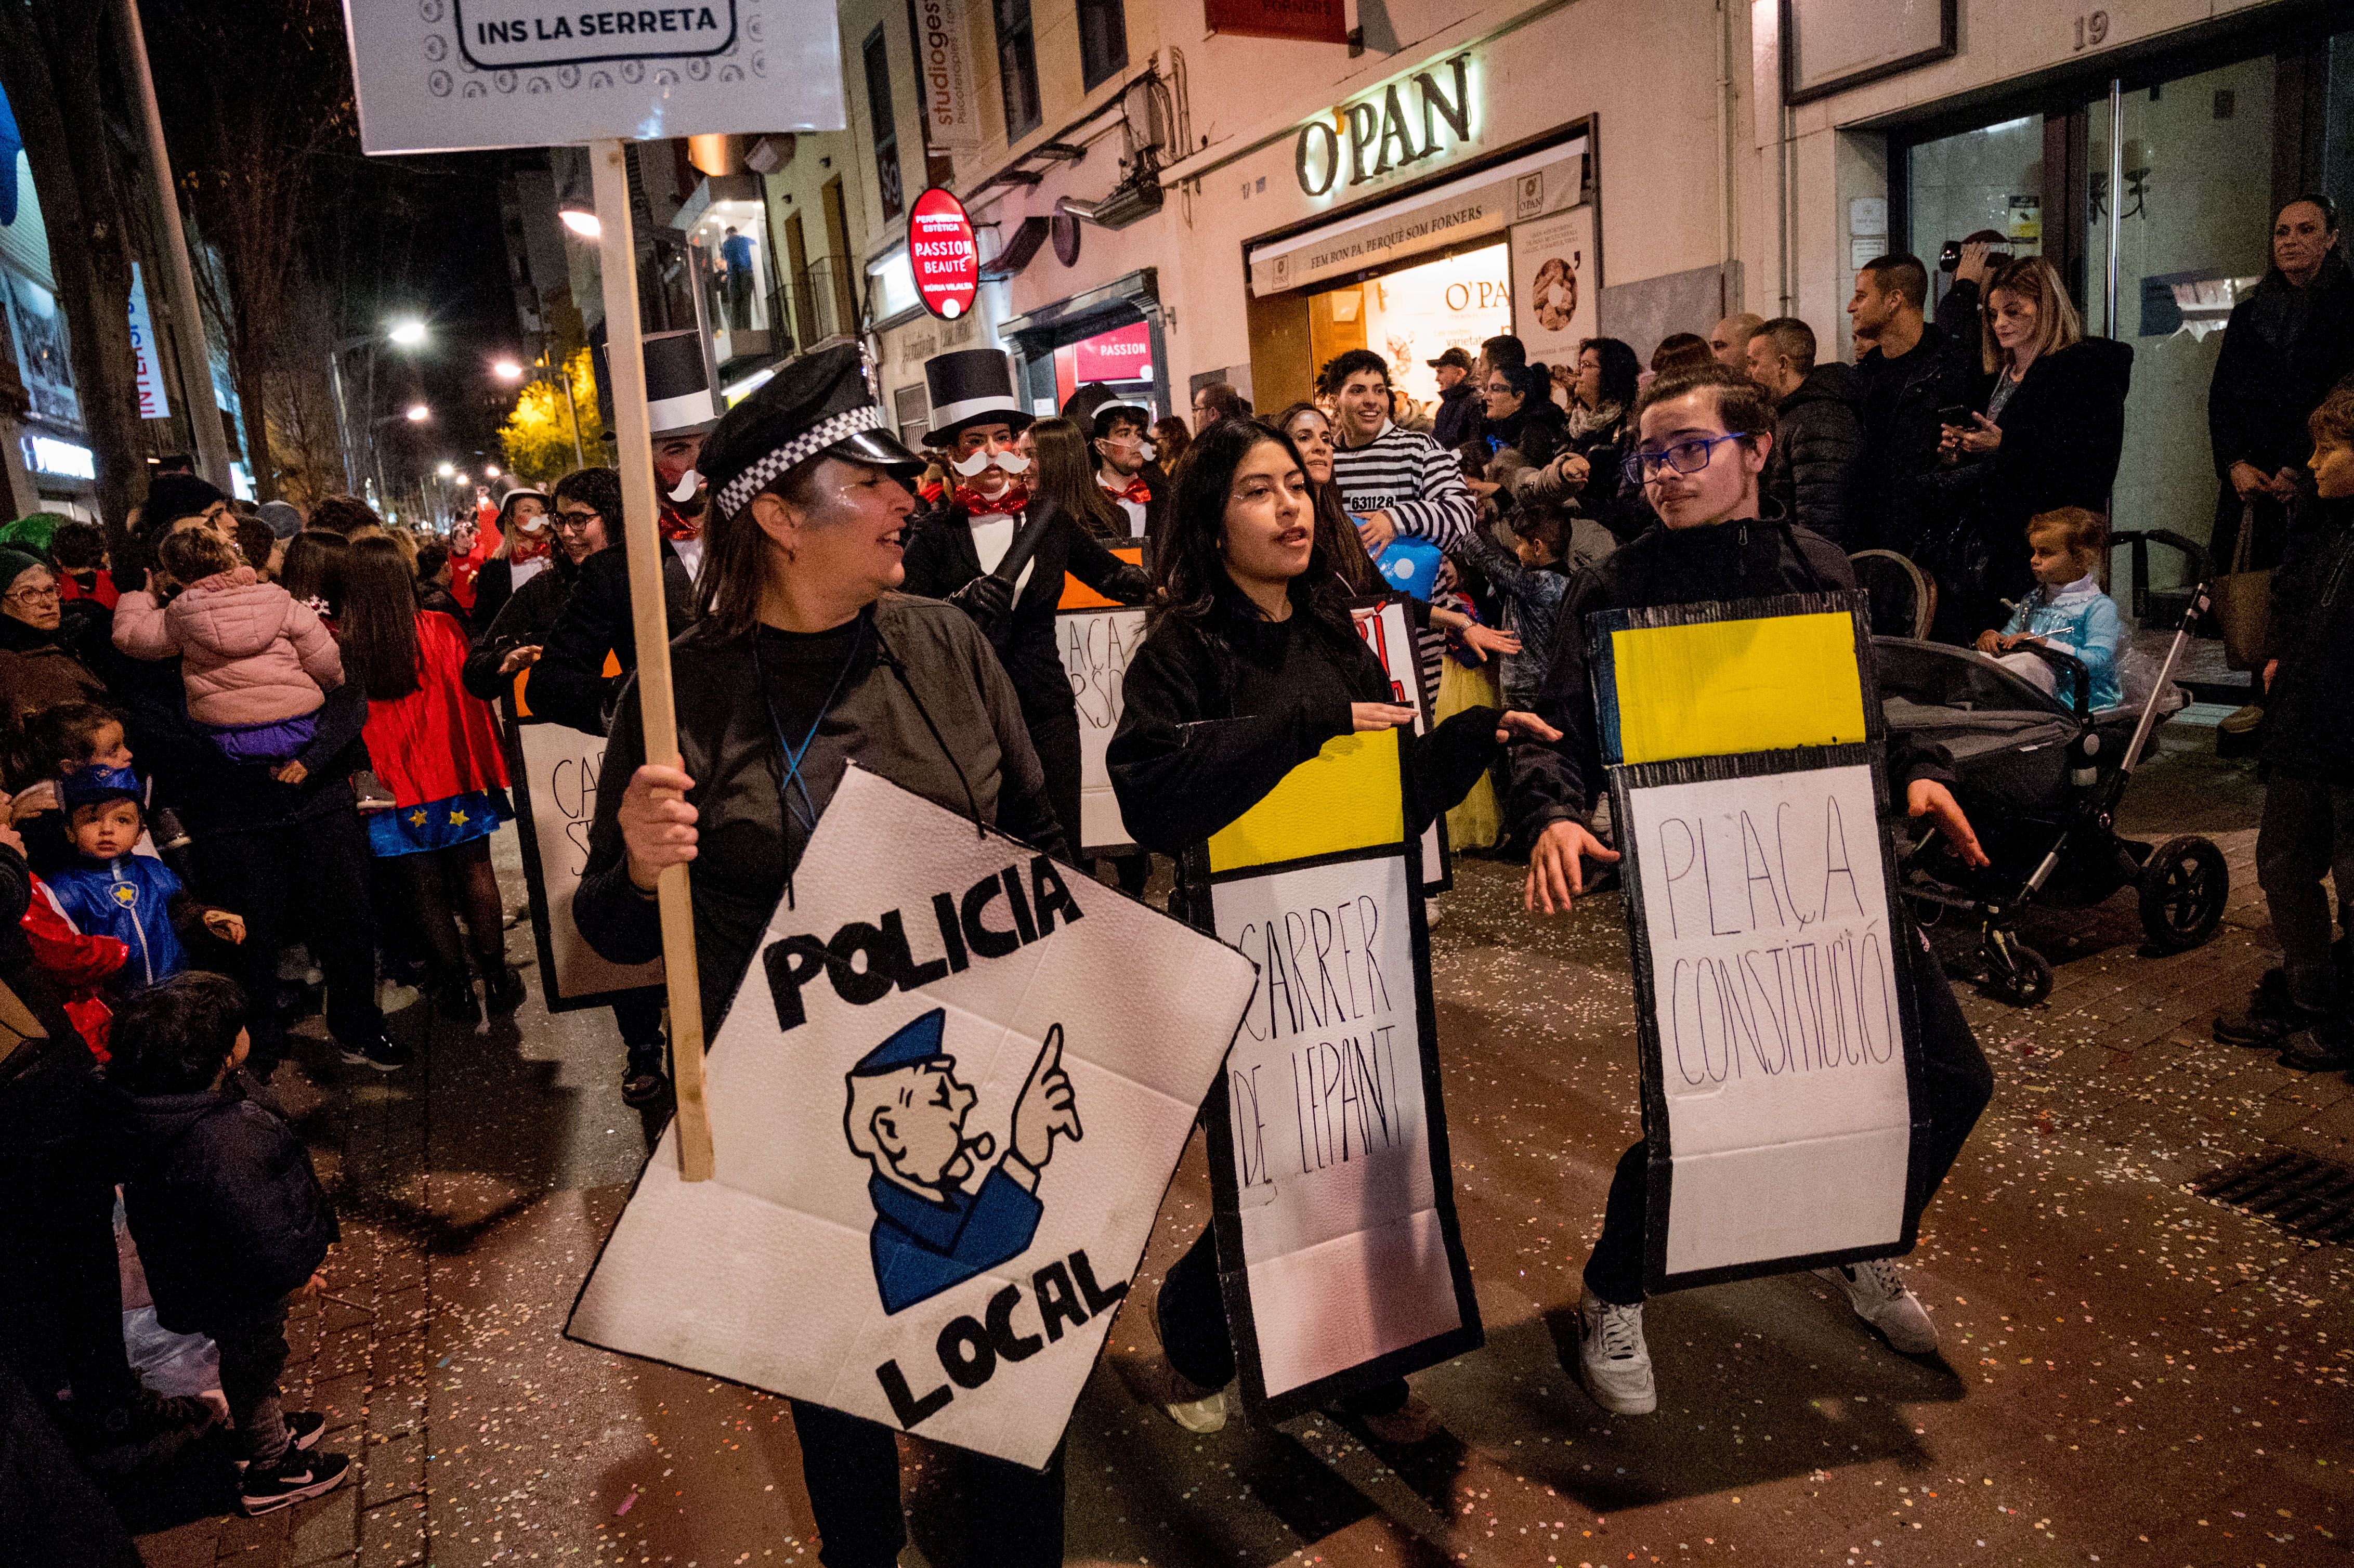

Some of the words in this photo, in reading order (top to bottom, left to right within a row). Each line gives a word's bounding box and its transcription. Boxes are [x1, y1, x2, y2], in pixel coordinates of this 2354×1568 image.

[477, 20, 529, 45] INS
[535, 16, 573, 41] LA
[579, 7, 717, 37] SERRETA
[2073, 10, 2109, 51] 19
[924, 0, 953, 125] studioges
[1295, 52, 1471, 197] O'PAN
[914, 240, 972, 257] PASSION
[1310, 253, 1328, 269] FEM
[1330, 245, 1351, 263] BON
[1406, 223, 1429, 242] SOM
[1432, 205, 1482, 233] FORNERS
[924, 255, 972, 274] BEAUTÉ
[946, 282, 974, 291] VILALTA
[1445, 279, 1509, 311] O'PA
[1100, 343, 1146, 356] PASSION
[1351, 495, 1394, 509] 631128
[1659, 794, 1864, 939] PLAÇA
[763, 854, 1085, 1033] POLICIA
[1239, 895, 1391, 1041] CARRER
[1234, 1065, 1272, 1188] DE
[1292, 1025, 1401, 1173] LEPANT
[875, 1249, 1131, 1431] LOCAL
